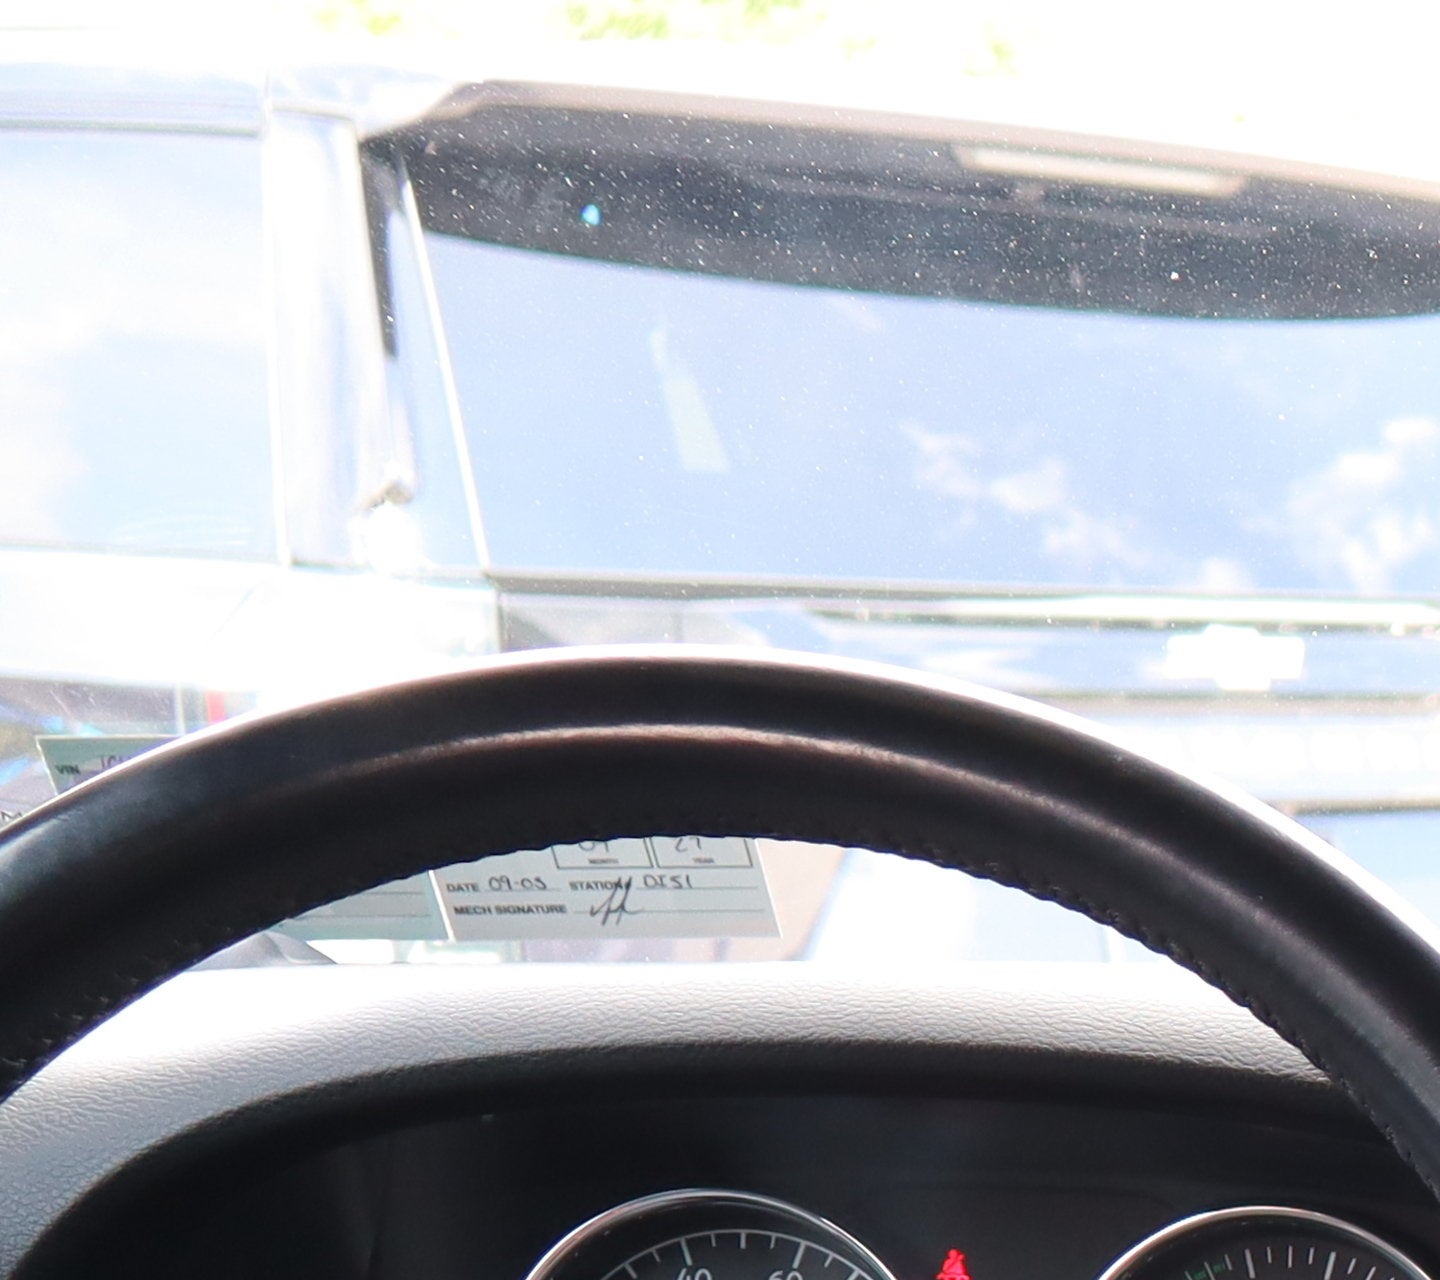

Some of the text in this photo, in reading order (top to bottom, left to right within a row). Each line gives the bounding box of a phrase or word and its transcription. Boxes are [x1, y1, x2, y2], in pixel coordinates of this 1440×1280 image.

[55, 763, 80, 775] VIN
[446, 882, 480, 893] DATE
[454, 904, 568, 916] MECH SIGNATURE
